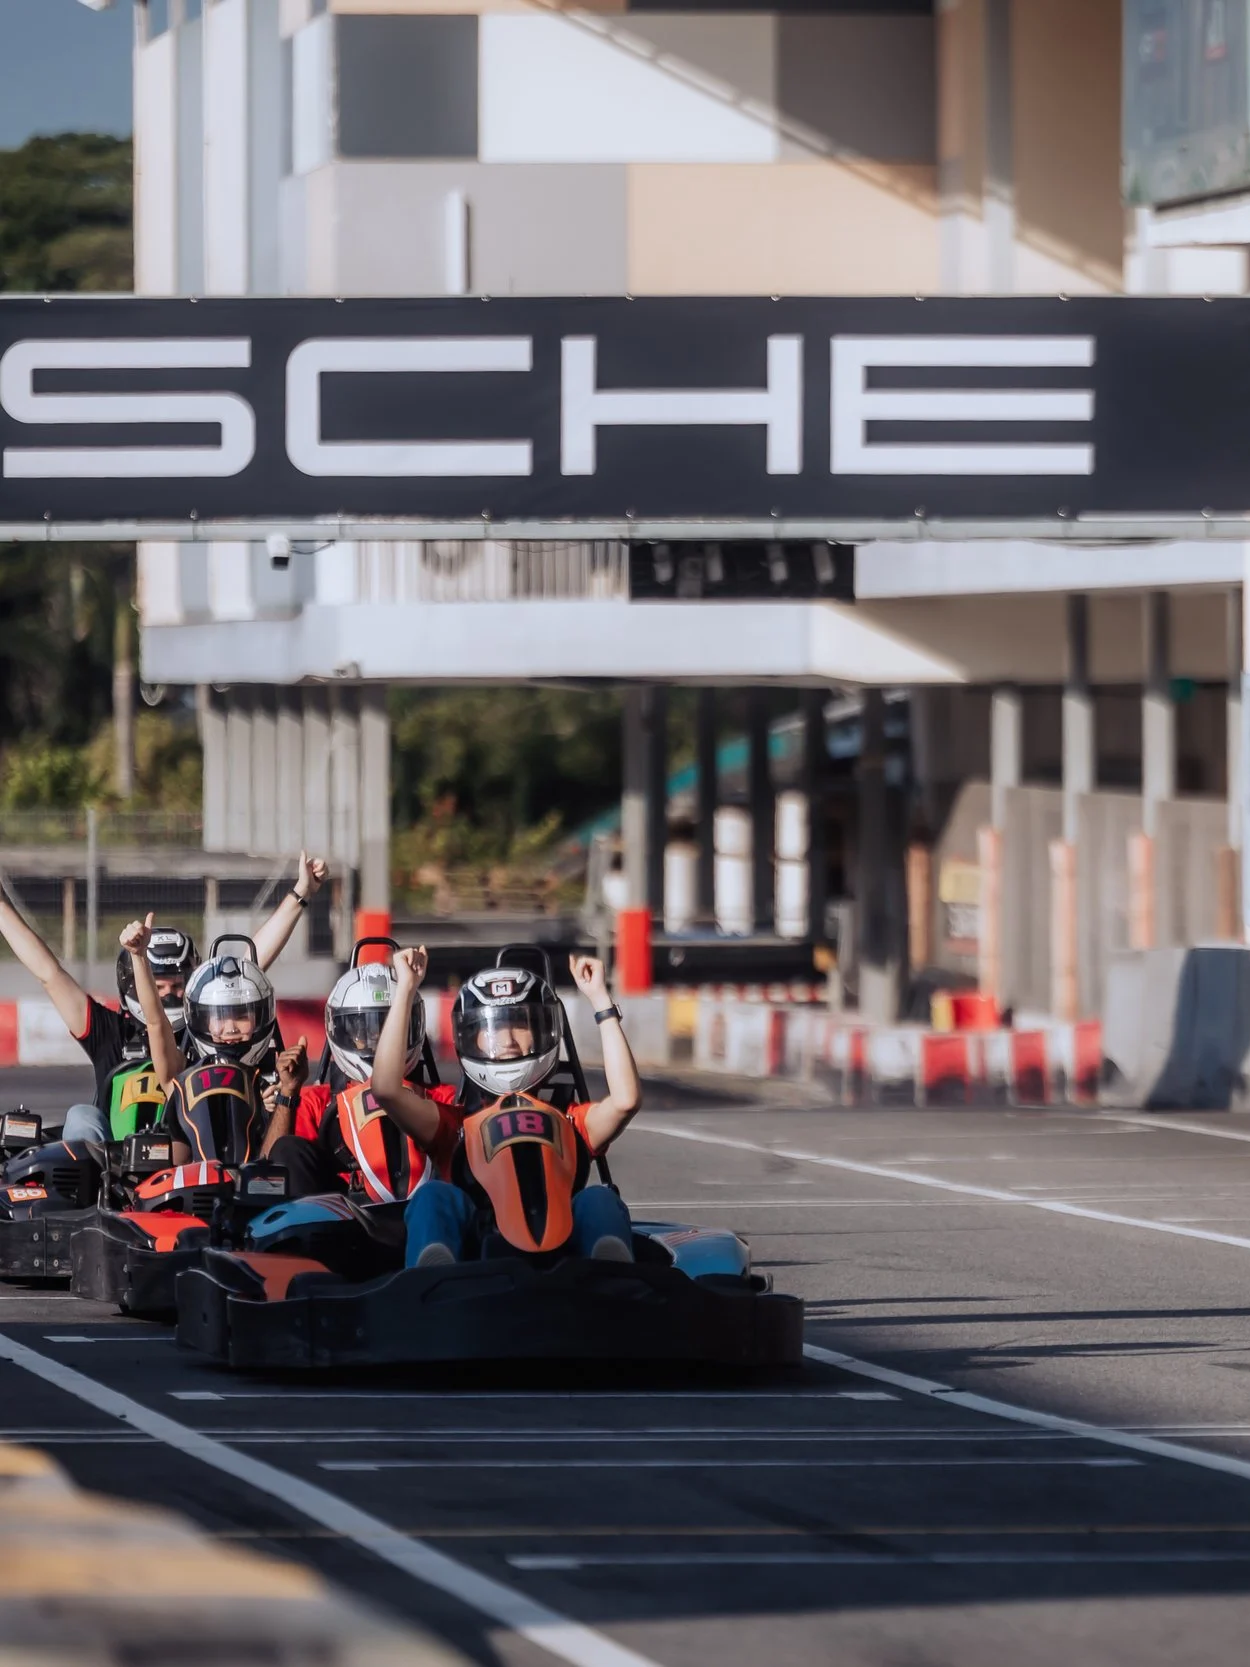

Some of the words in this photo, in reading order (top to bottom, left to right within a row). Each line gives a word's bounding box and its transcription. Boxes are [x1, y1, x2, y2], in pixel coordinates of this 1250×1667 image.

[0, 334, 1094, 477] SCHE
[198, 1067, 236, 1089] 17
[497, 1111, 545, 1138] 18
